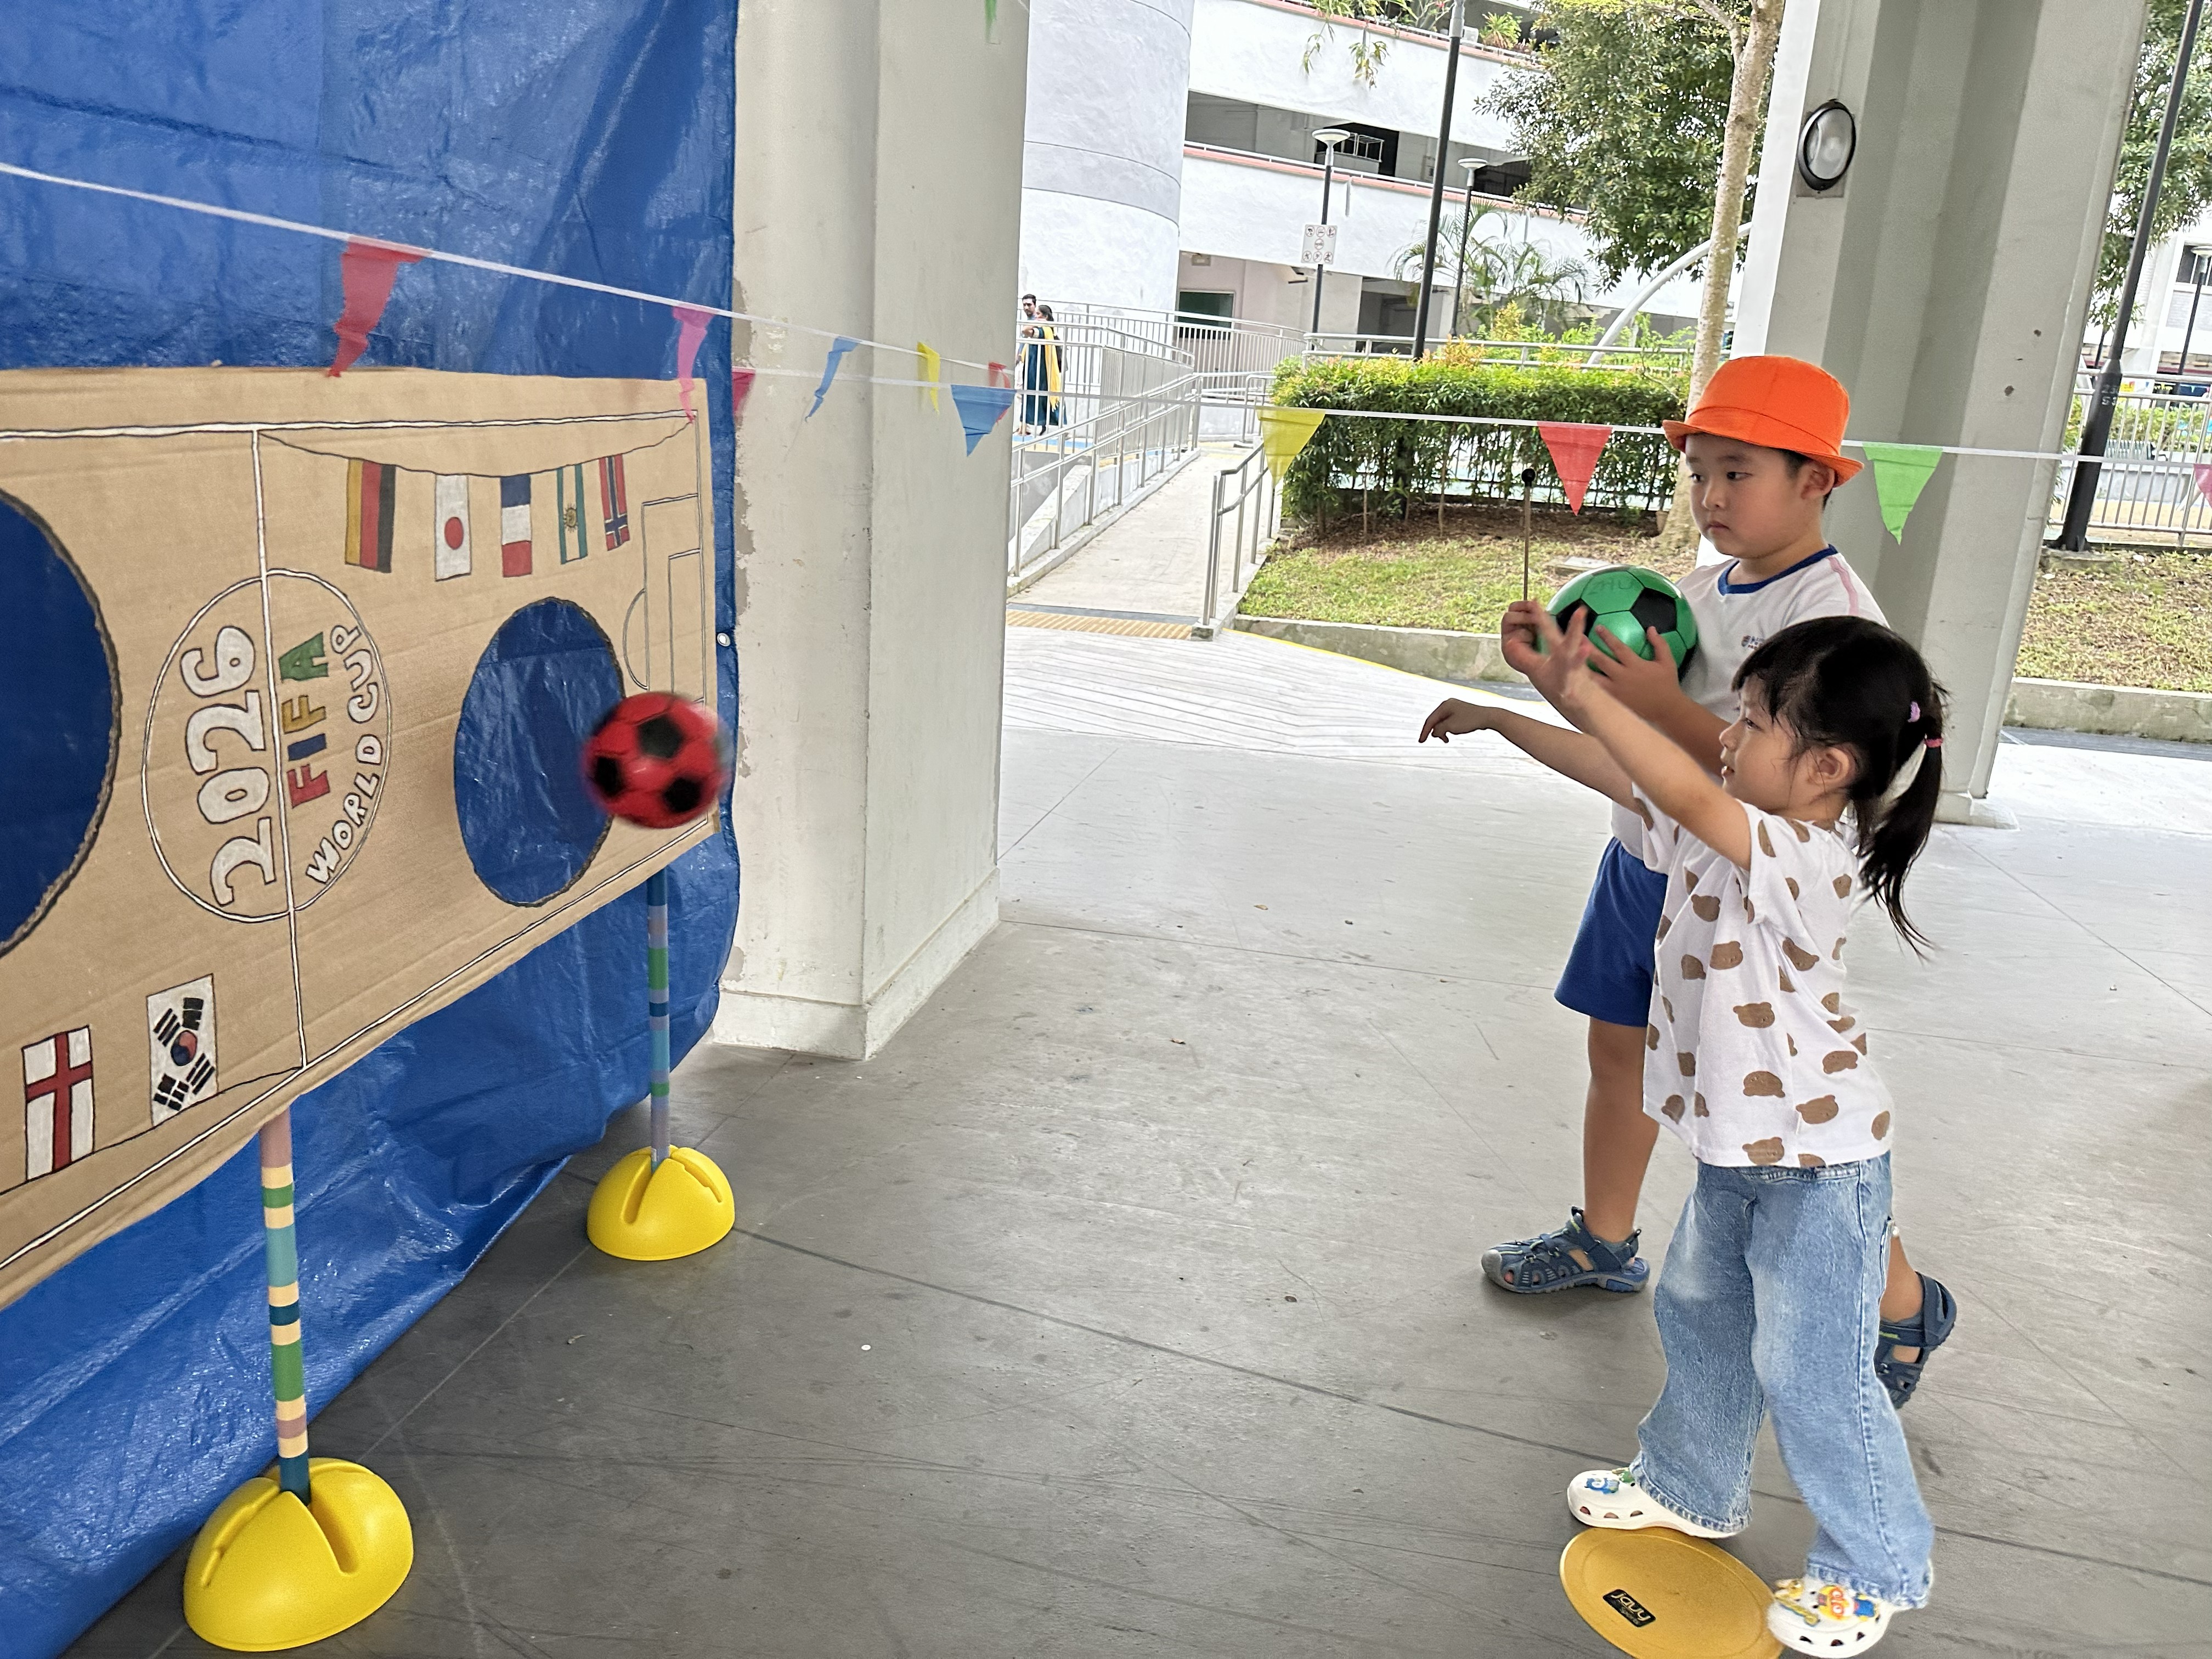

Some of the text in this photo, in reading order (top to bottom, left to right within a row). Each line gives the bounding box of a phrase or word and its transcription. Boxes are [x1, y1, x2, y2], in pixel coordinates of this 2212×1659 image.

[179, 626, 276, 907] 2026
[278, 631, 330, 809] FIFA
[305, 624, 382, 885] WORLD CUP
